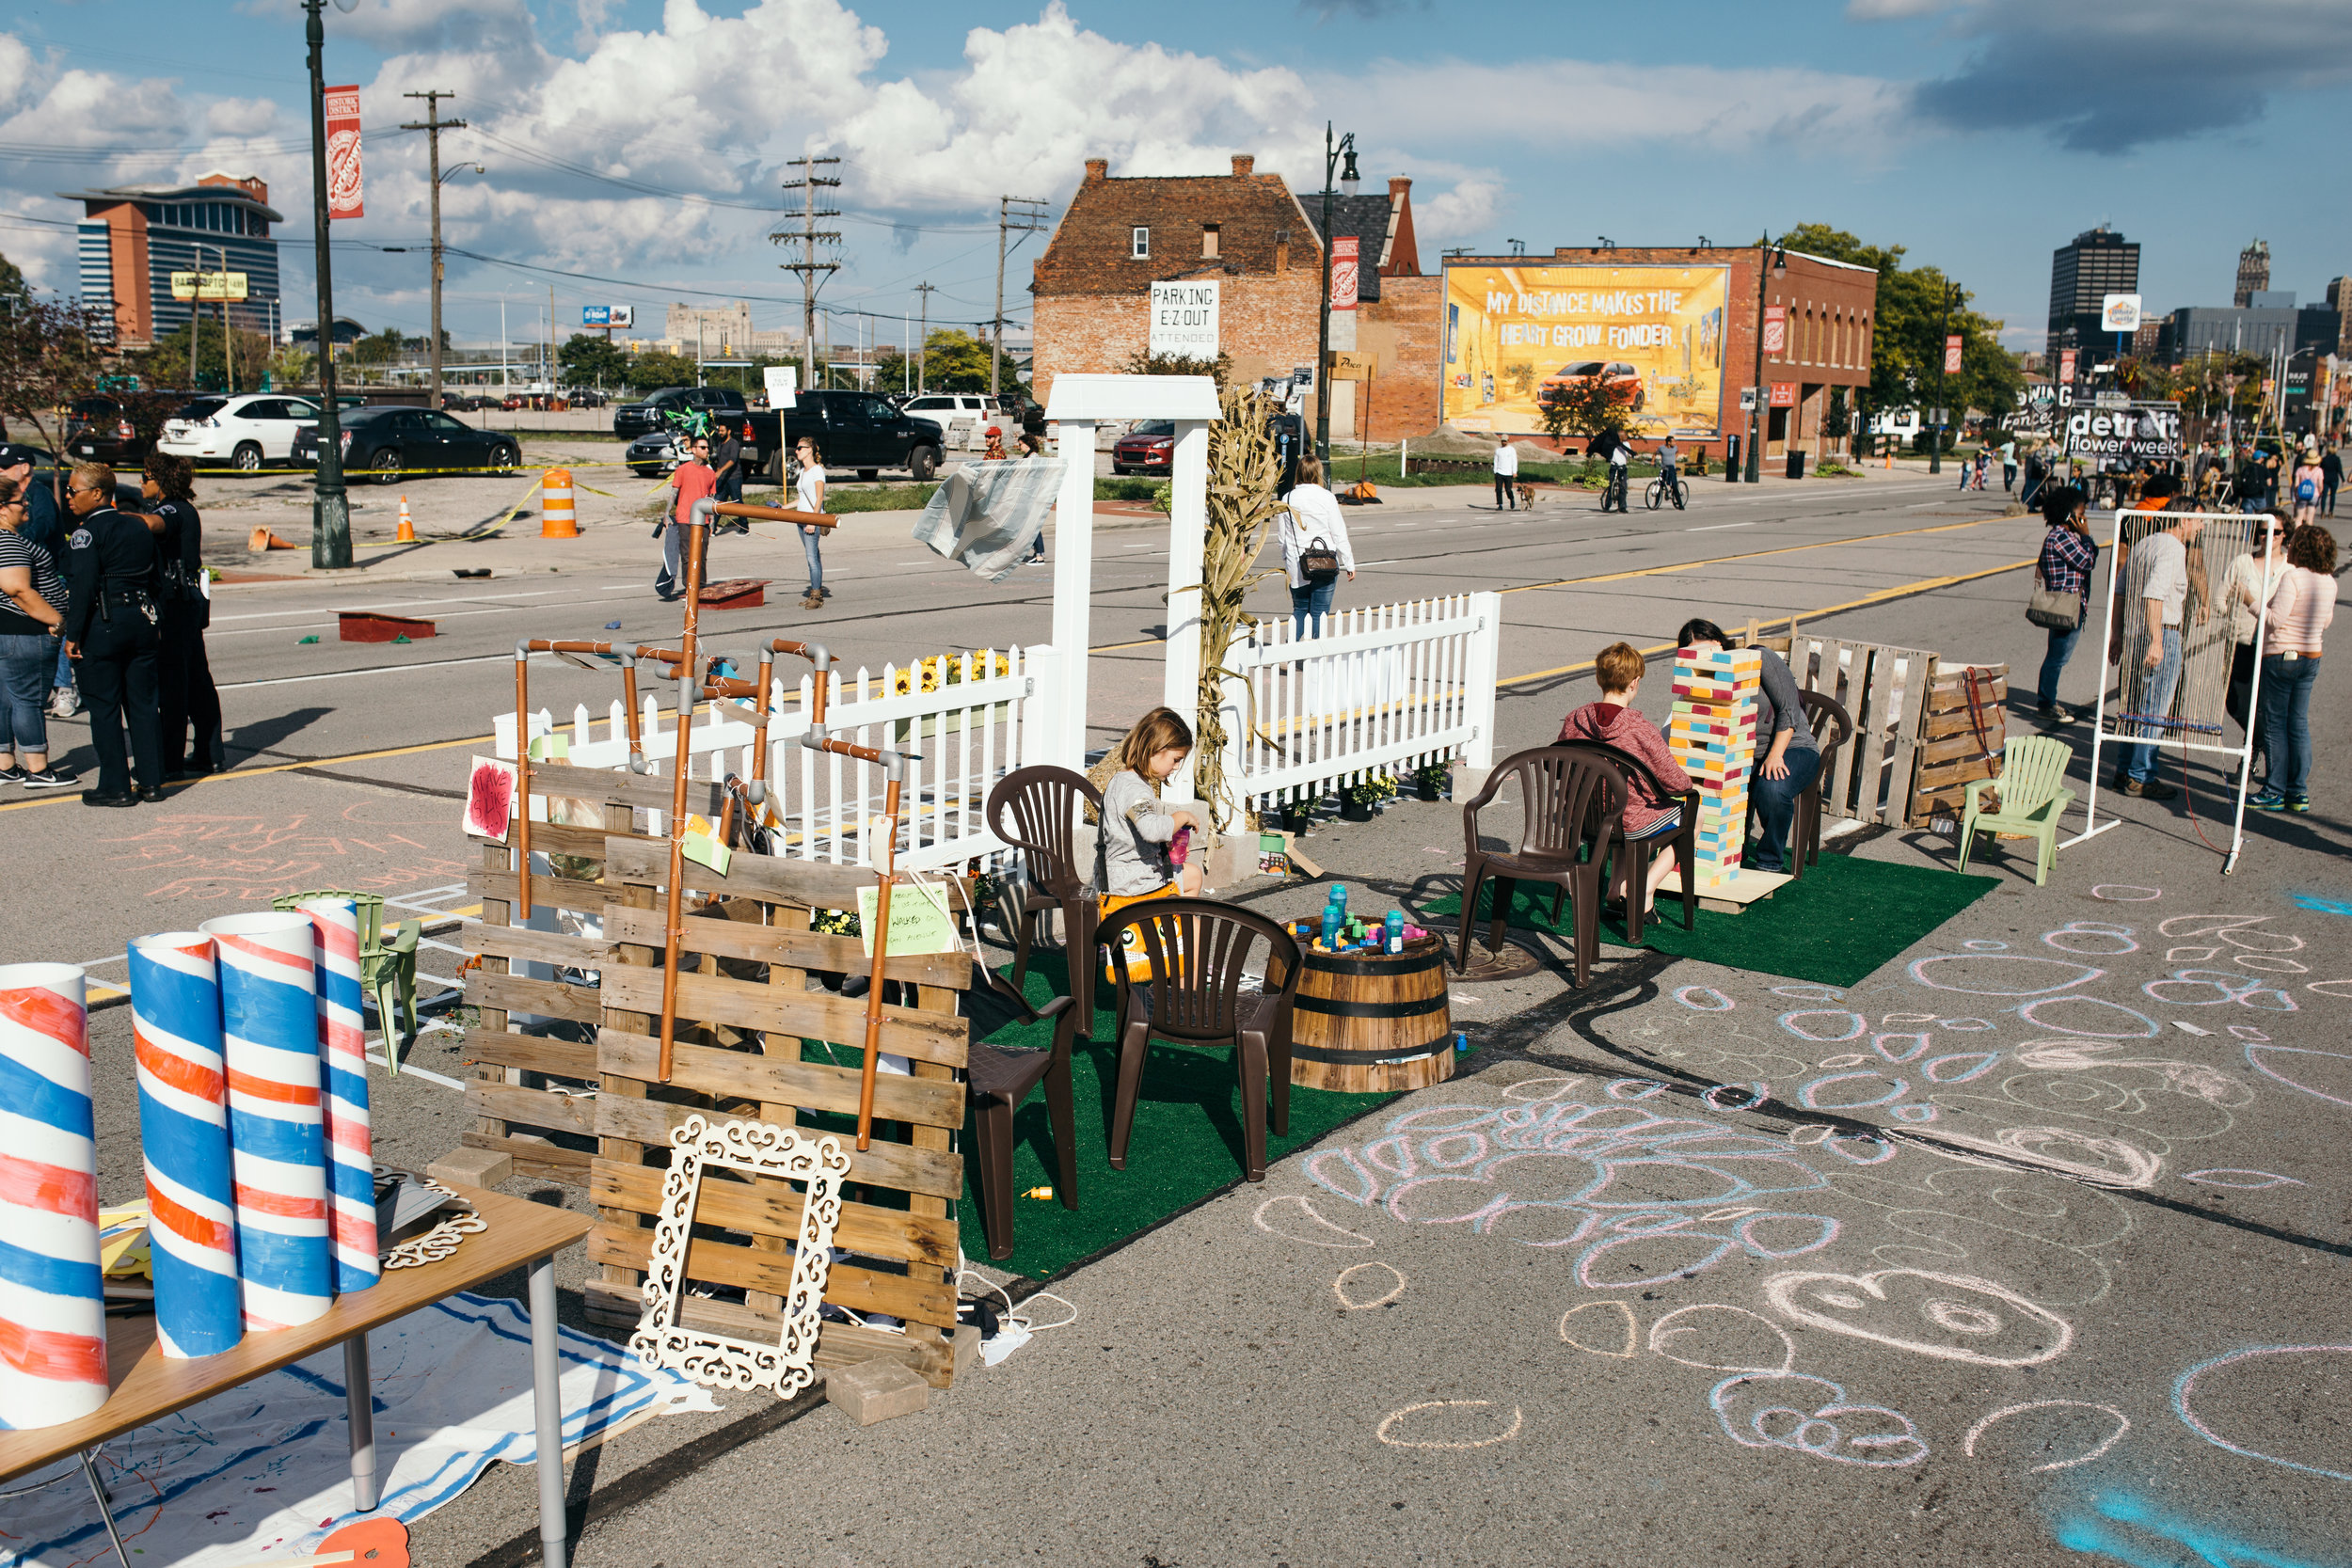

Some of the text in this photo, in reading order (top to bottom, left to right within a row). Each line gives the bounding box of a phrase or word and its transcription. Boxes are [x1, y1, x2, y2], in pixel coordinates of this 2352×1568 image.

[326, 96, 358, 107] HISTORIC
[328, 105, 358, 115] DISTRICT
[1152, 288, 1213, 306] PARKING
[1486, 290, 1682, 317] MY DISTANCE MAKES THE
[1151, 333, 1215, 342] ATTENDED
[1501, 323, 1549, 346] HEART
[1552, 325, 1601, 347] GROW
[2069, 434, 2178, 455] flower week
[891, 914, 921, 927] WALKED
[907, 930, 937, 942] AVENUE
